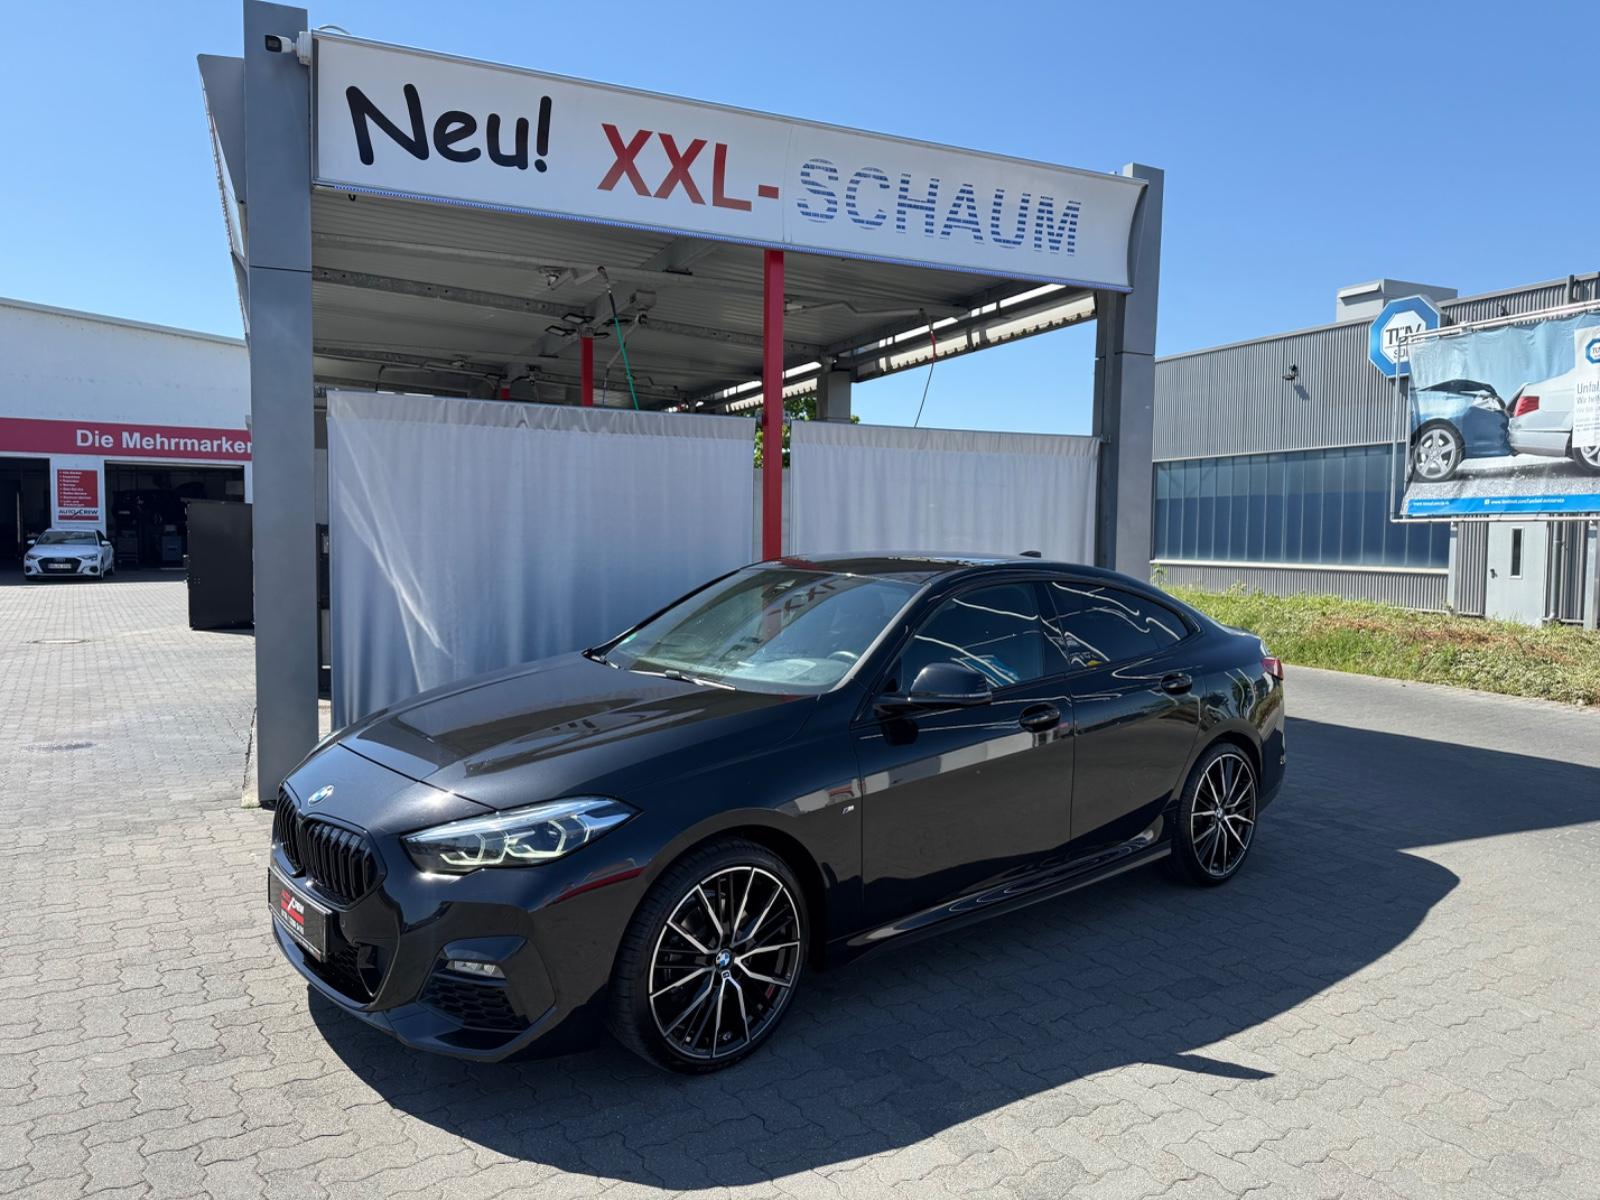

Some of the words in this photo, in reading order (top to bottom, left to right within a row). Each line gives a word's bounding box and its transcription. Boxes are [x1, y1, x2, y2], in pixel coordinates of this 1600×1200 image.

[345, 82, 553, 173] Neu!
[597, 122, 780, 211] XXL-
[796, 157, 1082, 258] SCHAUM
[76, 429, 114, 448] Die
